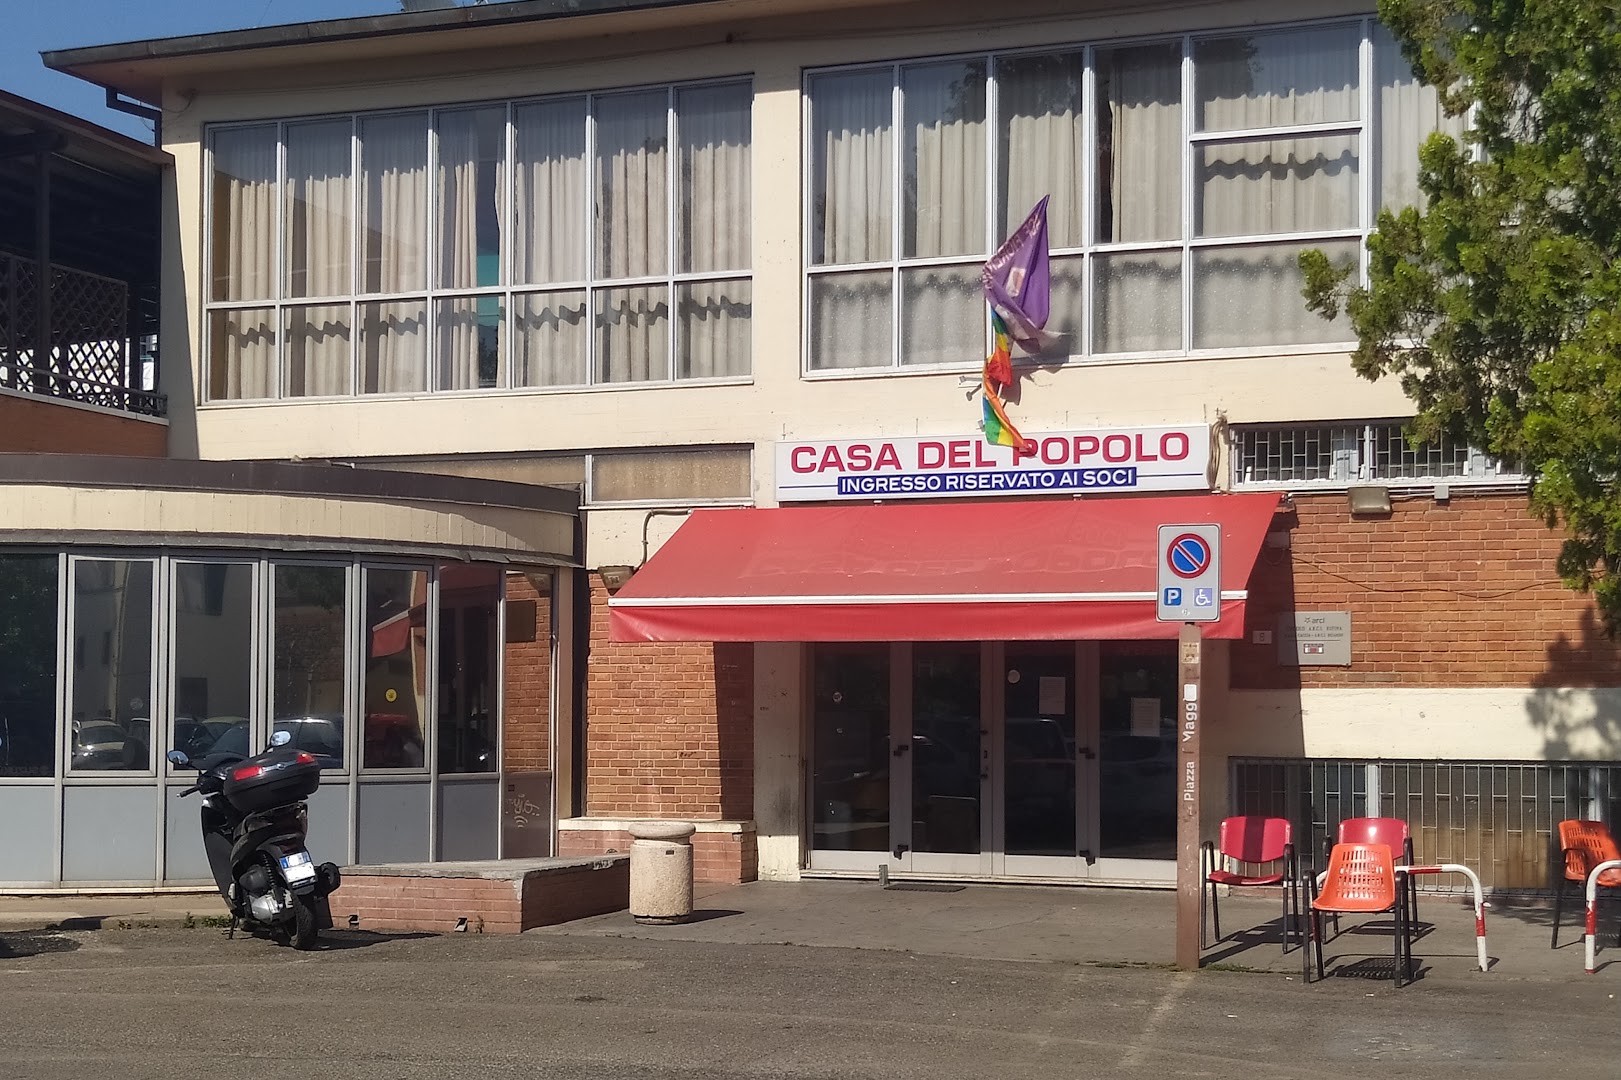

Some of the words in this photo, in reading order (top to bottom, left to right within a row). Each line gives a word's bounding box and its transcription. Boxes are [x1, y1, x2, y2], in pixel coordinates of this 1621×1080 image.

[791, 443, 902, 473] CASA
[917, 440, 997, 469] DEL
[1012, 432, 1189, 467] POPOLO
[841, 475, 941, 493] INGRESSO
[945, 473, 1055, 490] RISERVATO
[1059, 473, 1077, 486] AI
[1083, 470, 1133, 486] SOCI
[1167, 590, 1179, 604] P
[1182, 694, 1198, 742] Magg
[1183, 761, 1195, 801] Piazza
